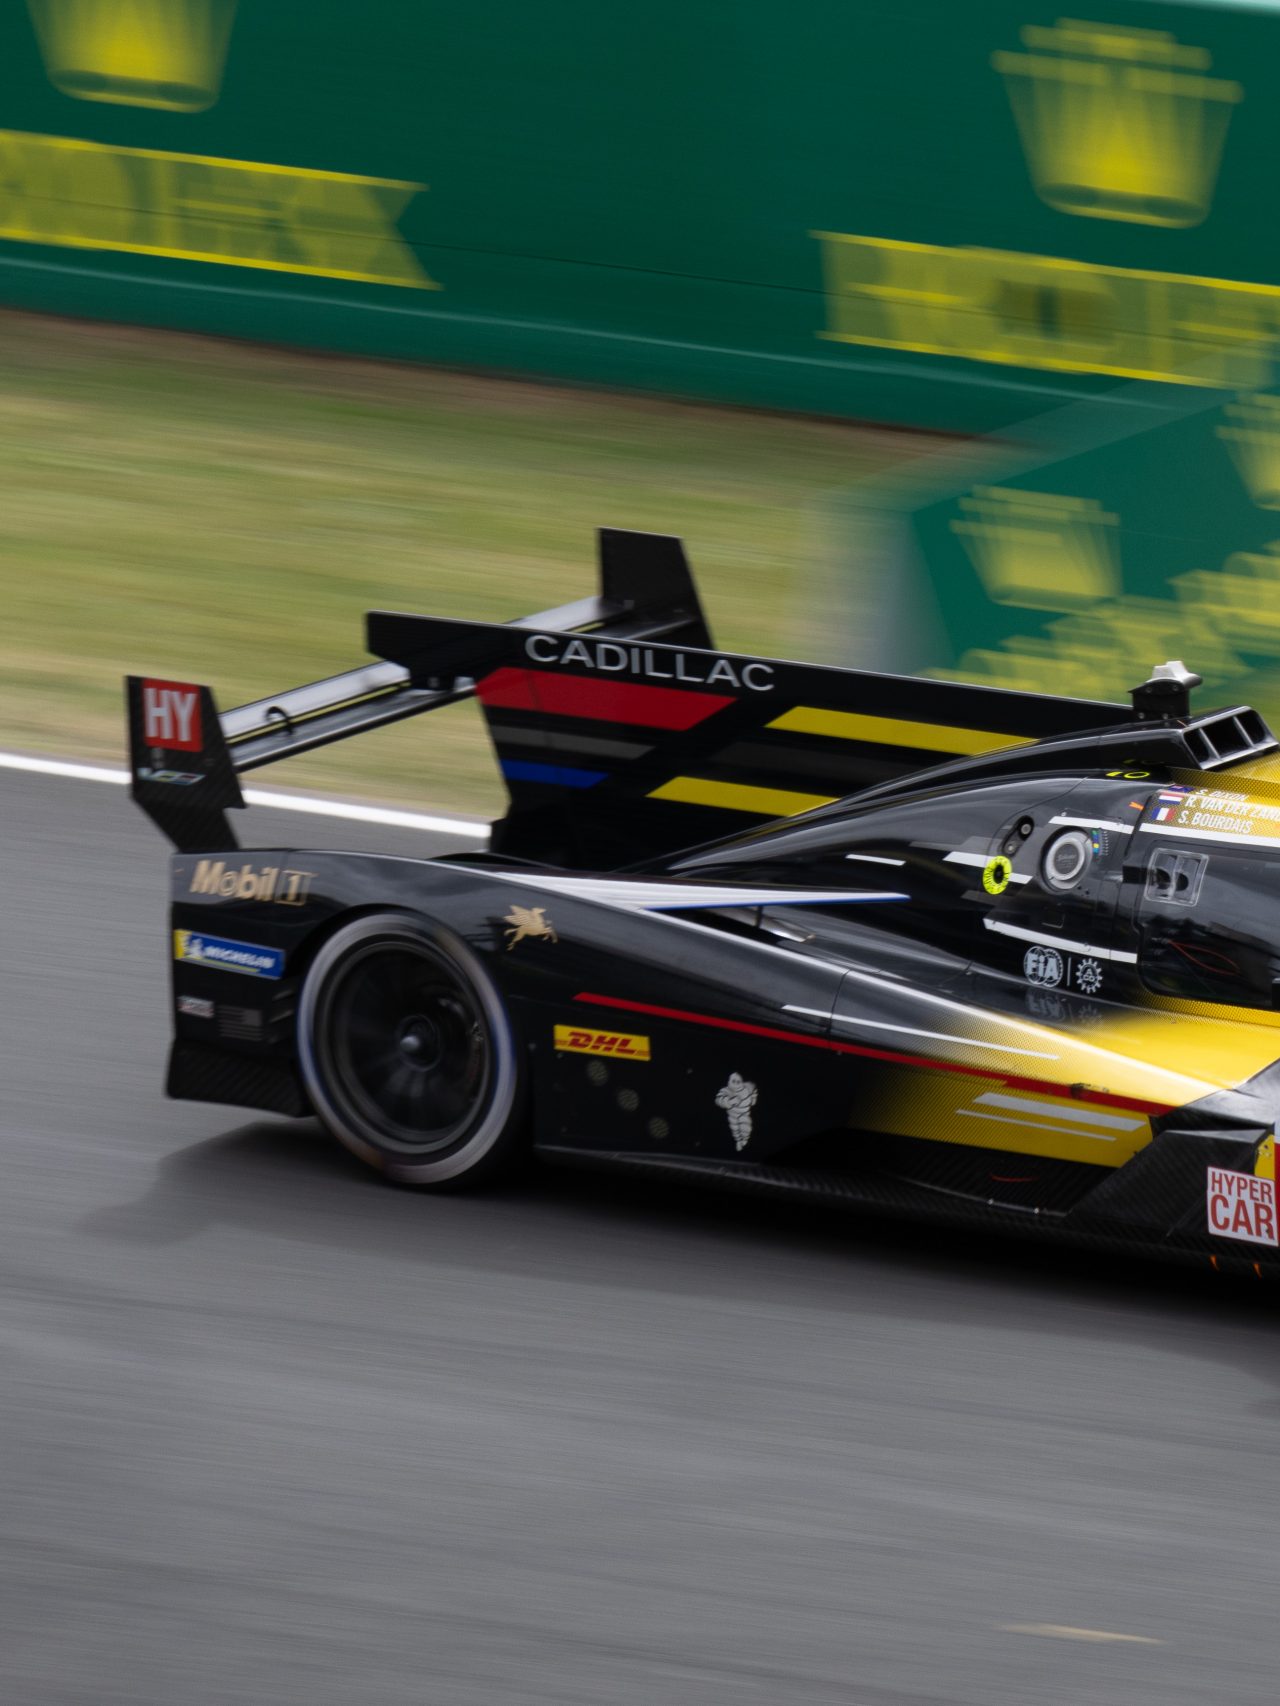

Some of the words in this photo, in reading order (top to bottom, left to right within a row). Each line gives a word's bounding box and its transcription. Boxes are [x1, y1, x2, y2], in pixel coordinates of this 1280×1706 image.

[523, 634, 775, 692] CADILLAC
[143, 687, 198, 742] HY
[1178, 810, 1189, 824] S.
[1191, 812, 1254, 834] BOURDAIS
[1184, 796, 1196, 807] R.
[1199, 798, 1224, 811] VAN
[189, 859, 279, 902] Mobil
[568, 1031, 636, 1055] DHL
[1211, 1171, 1273, 1205] HYPER
[1210, 1194, 1275, 1241] CAR
